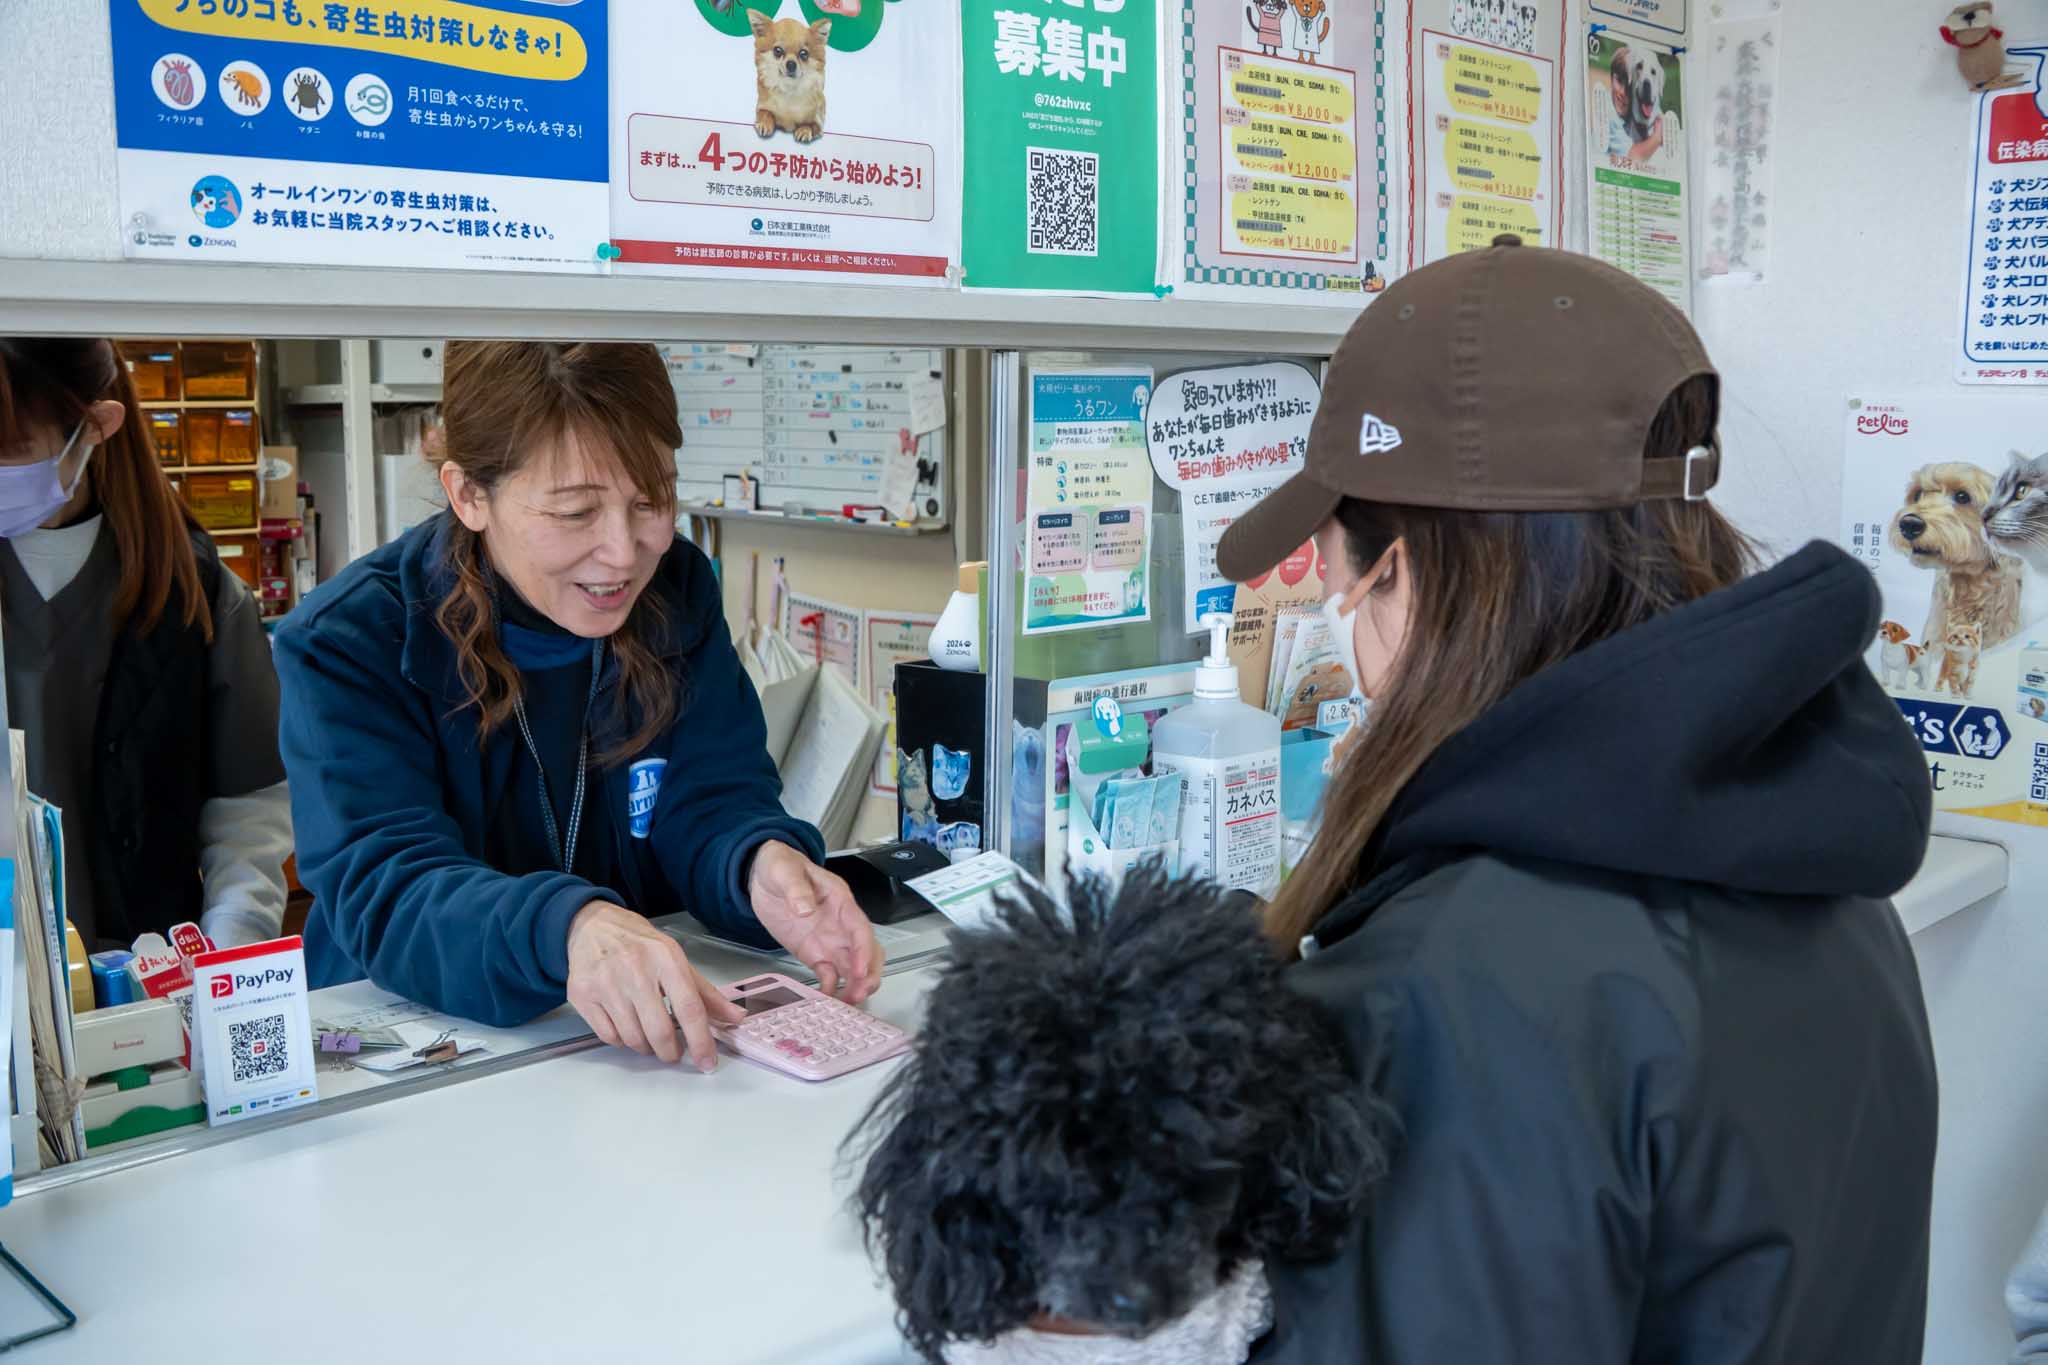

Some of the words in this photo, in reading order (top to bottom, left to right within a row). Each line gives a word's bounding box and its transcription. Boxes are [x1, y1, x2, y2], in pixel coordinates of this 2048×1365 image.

[993, 9, 1127, 88] 募集中
[407, 86, 530, 113] 月1回食べるだけで、
[1034, 92, 1092, 112] @762zhvxc
[408, 108, 583, 139] 寄生虫からワンちゃんを守る！
[706, 182, 874, 207] 予防できる病気は、しっかり予防しましょう。
[252, 208, 554, 241] お気軽に当院スタッフへご相談ください。
[1074, 399, 1119, 417] うるワン
[1152, 398, 1312, 444] あなたが毎日歯みがきするように
[1168, 435, 1225, 461] ワンちゃんも
[1178, 436, 1307, 481] 毎日の歯みがきが必要です
[946, 639, 963, 648] 2024
[236, 967, 294, 989] PayPay
